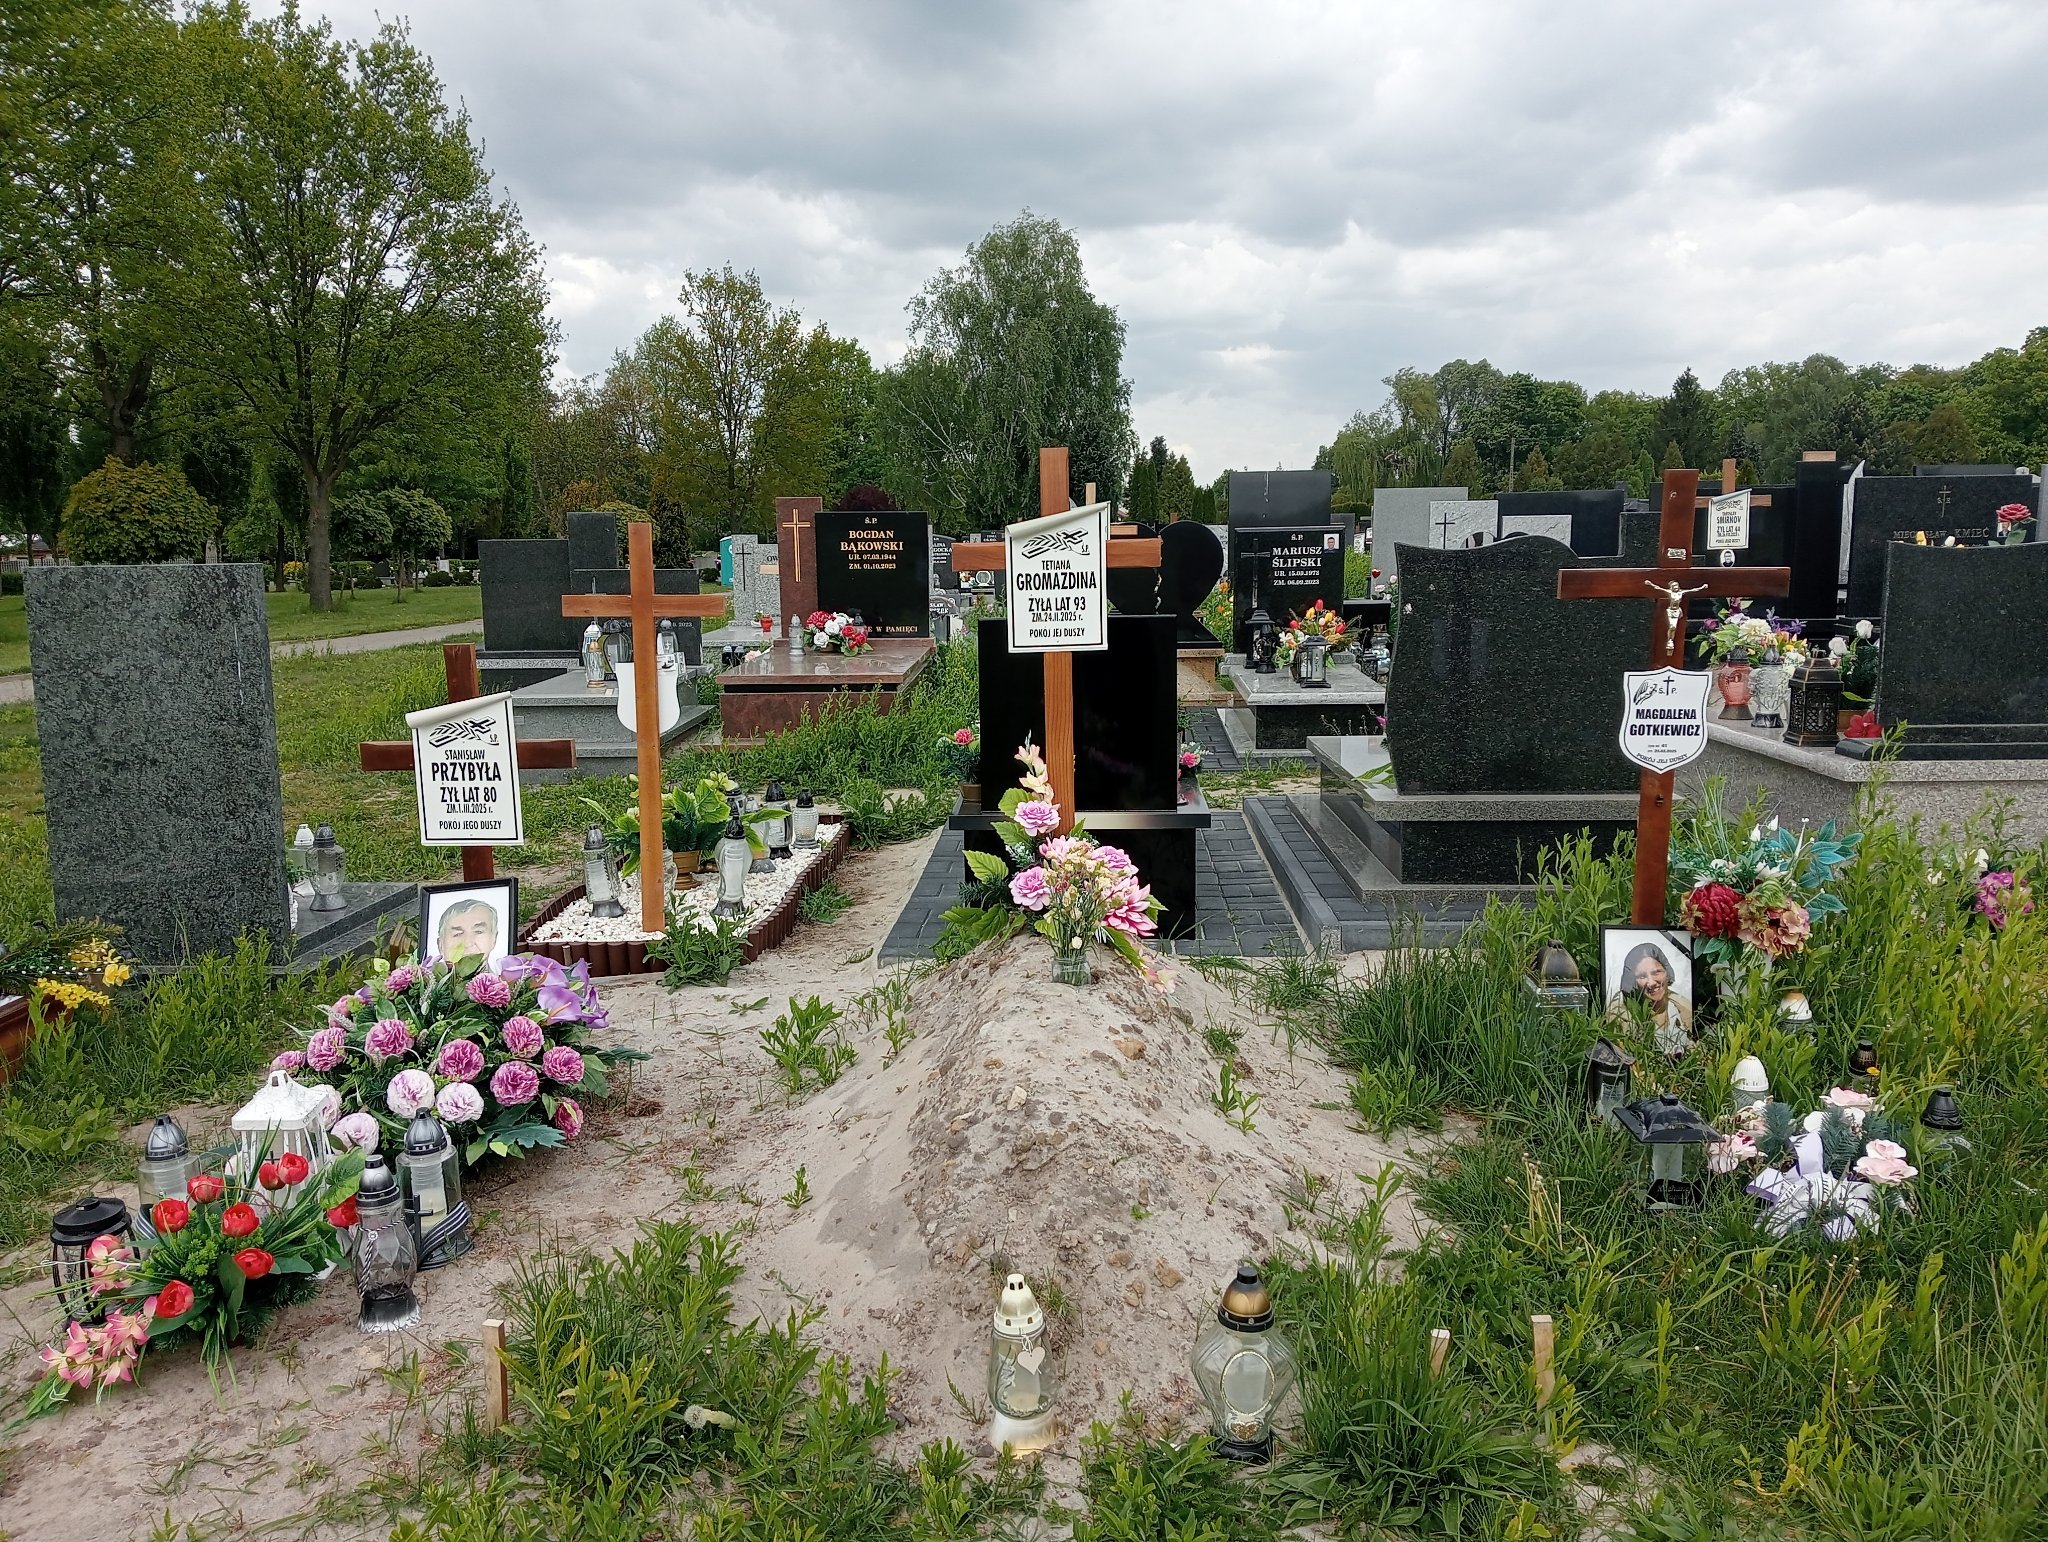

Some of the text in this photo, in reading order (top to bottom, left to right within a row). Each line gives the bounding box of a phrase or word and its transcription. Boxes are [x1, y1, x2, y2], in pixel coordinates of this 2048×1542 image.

[1717, 516, 1741, 524] SMIRNOV
[849, 530, 894, 539] BOGDAN
[1893, 527, 1990, 539] MIECSŁAW KMIEĆ
[840, 541, 904, 553] BĄKOWSKI
[1272, 546, 1322, 556] MARIUSZ
[1042, 560, 1071, 570] TETIANA
[1272, 556, 1322, 568] ŚLIPSKI
[1016, 571, 1097, 591] GROMAZDINA
[1028, 594, 1086, 612] ŻYŁA LAT 93
[886, 626, 918, 634] PAMIĘCI
[1030, 626, 1085, 638] POKÓJ JEJ DUSZY
[1636, 708, 1697, 720] MAGDALENA
[1630, 724, 1701, 736] GOTKIEWICZ
[444, 749, 486, 760] STANISŁAW
[432, 762, 502, 782] PRZYBYŁA
[462, 786, 480, 803] LAT
[484, 786, 497, 803] 80
[439, 818, 502, 830] POKÓJ JEGO DUSZY
